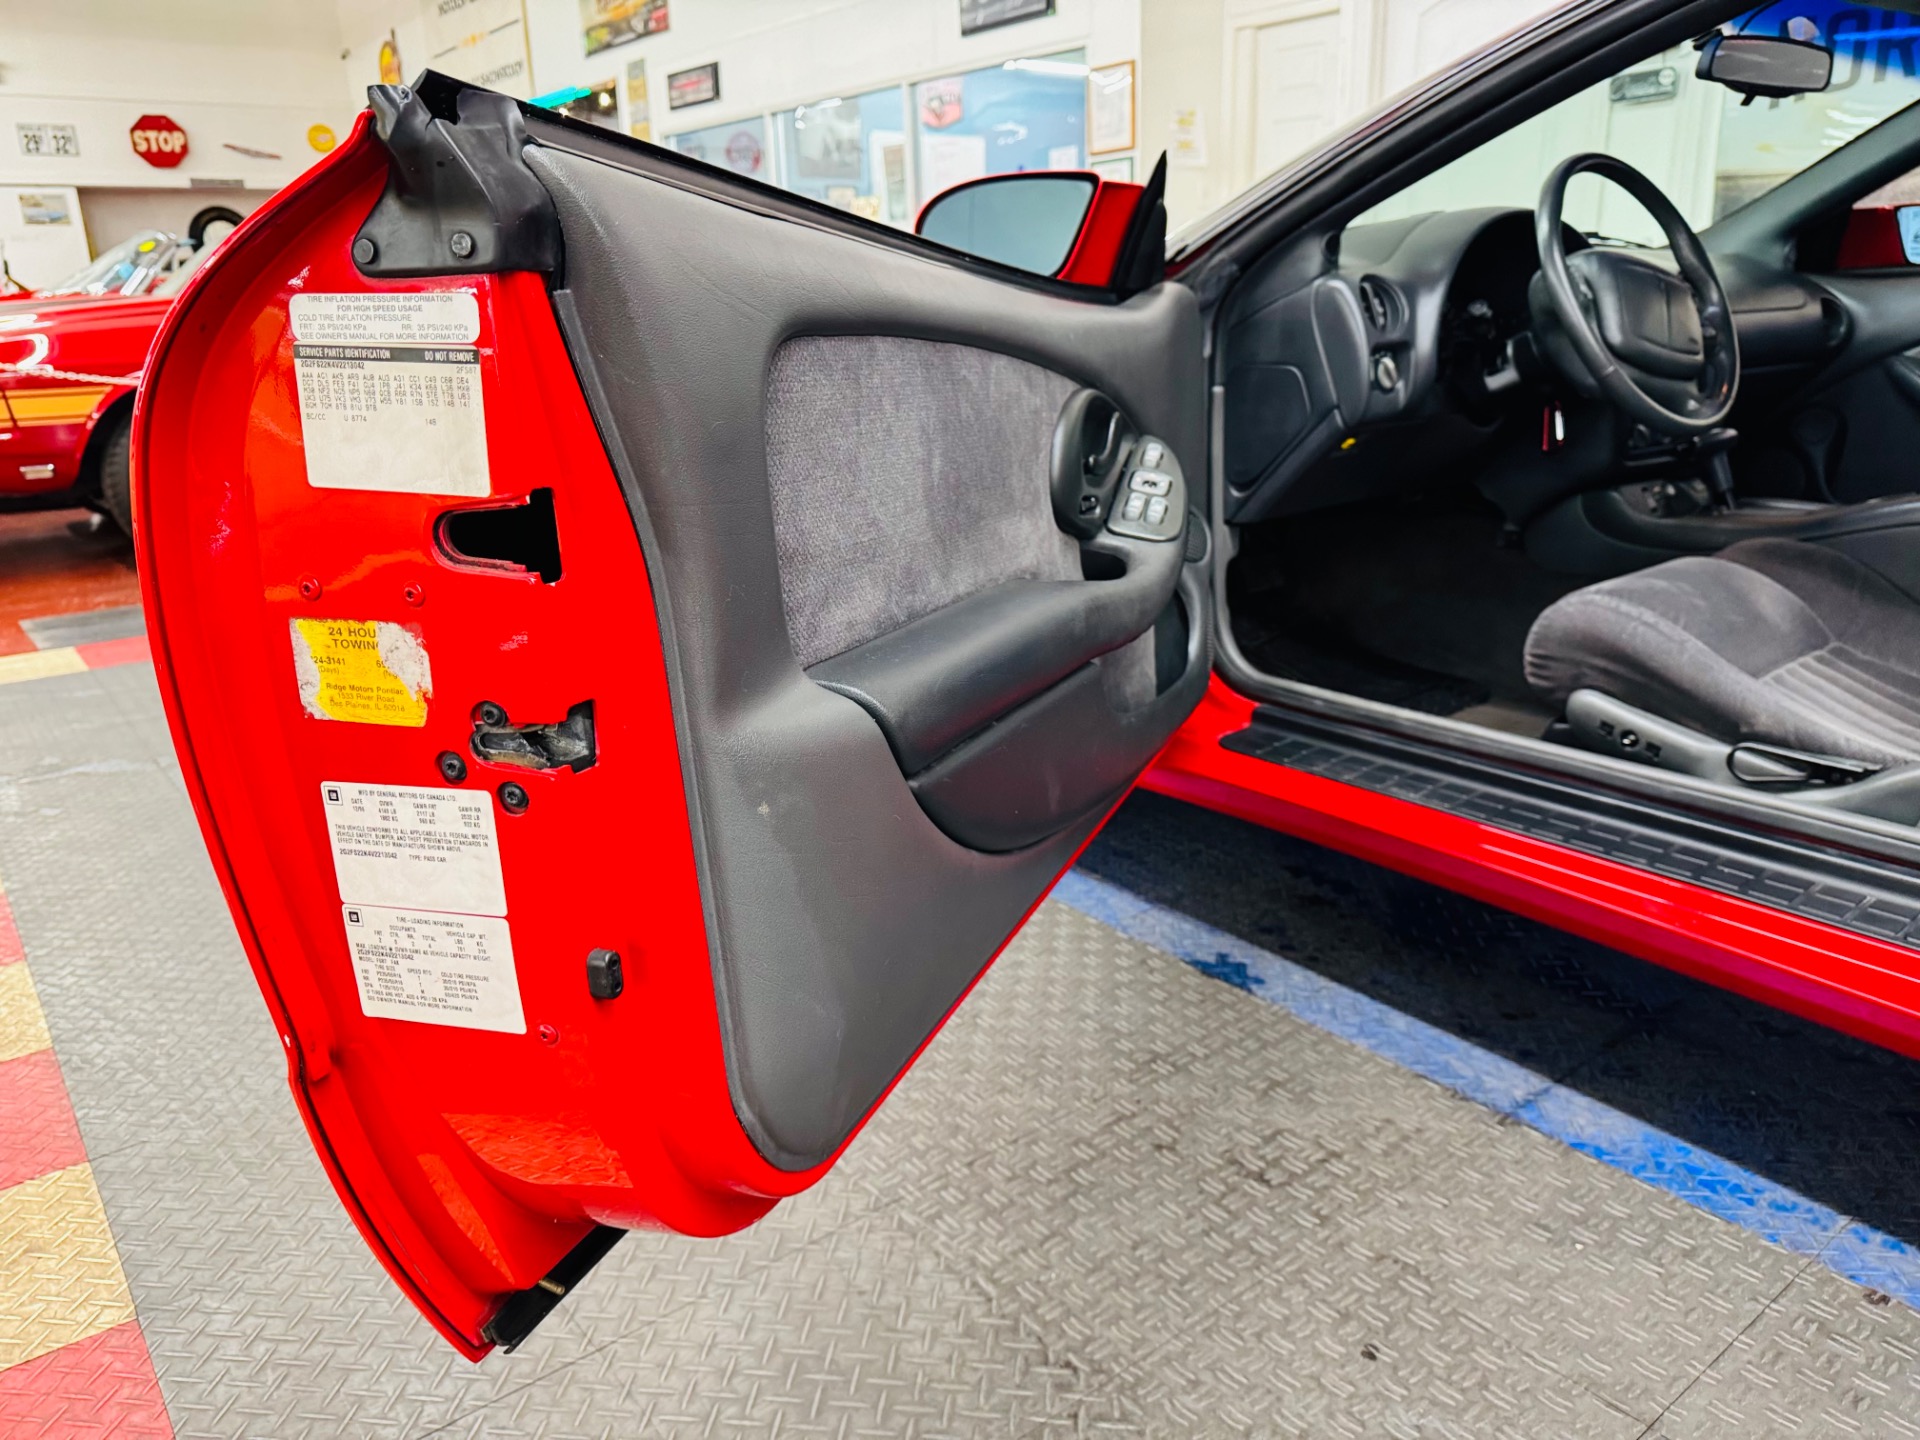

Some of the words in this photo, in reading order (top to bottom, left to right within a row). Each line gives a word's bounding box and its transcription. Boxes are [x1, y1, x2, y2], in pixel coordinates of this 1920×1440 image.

[132, 129, 187, 153] STOP
[299, 346, 323, 357] SERVICE
[324, 347, 344, 357] PARTS
[345, 348, 391, 359] IDENTIFICATION
[424, 350, 434, 361] DO
[434, 351, 447, 361] NOT
[449, 351, 474, 362] REMOVE
[328, 627, 342, 636] 24
[326, 683, 346, 692] Ridge
[349, 684, 374, 693] Motors
[376, 686, 404, 695] Pontiac
